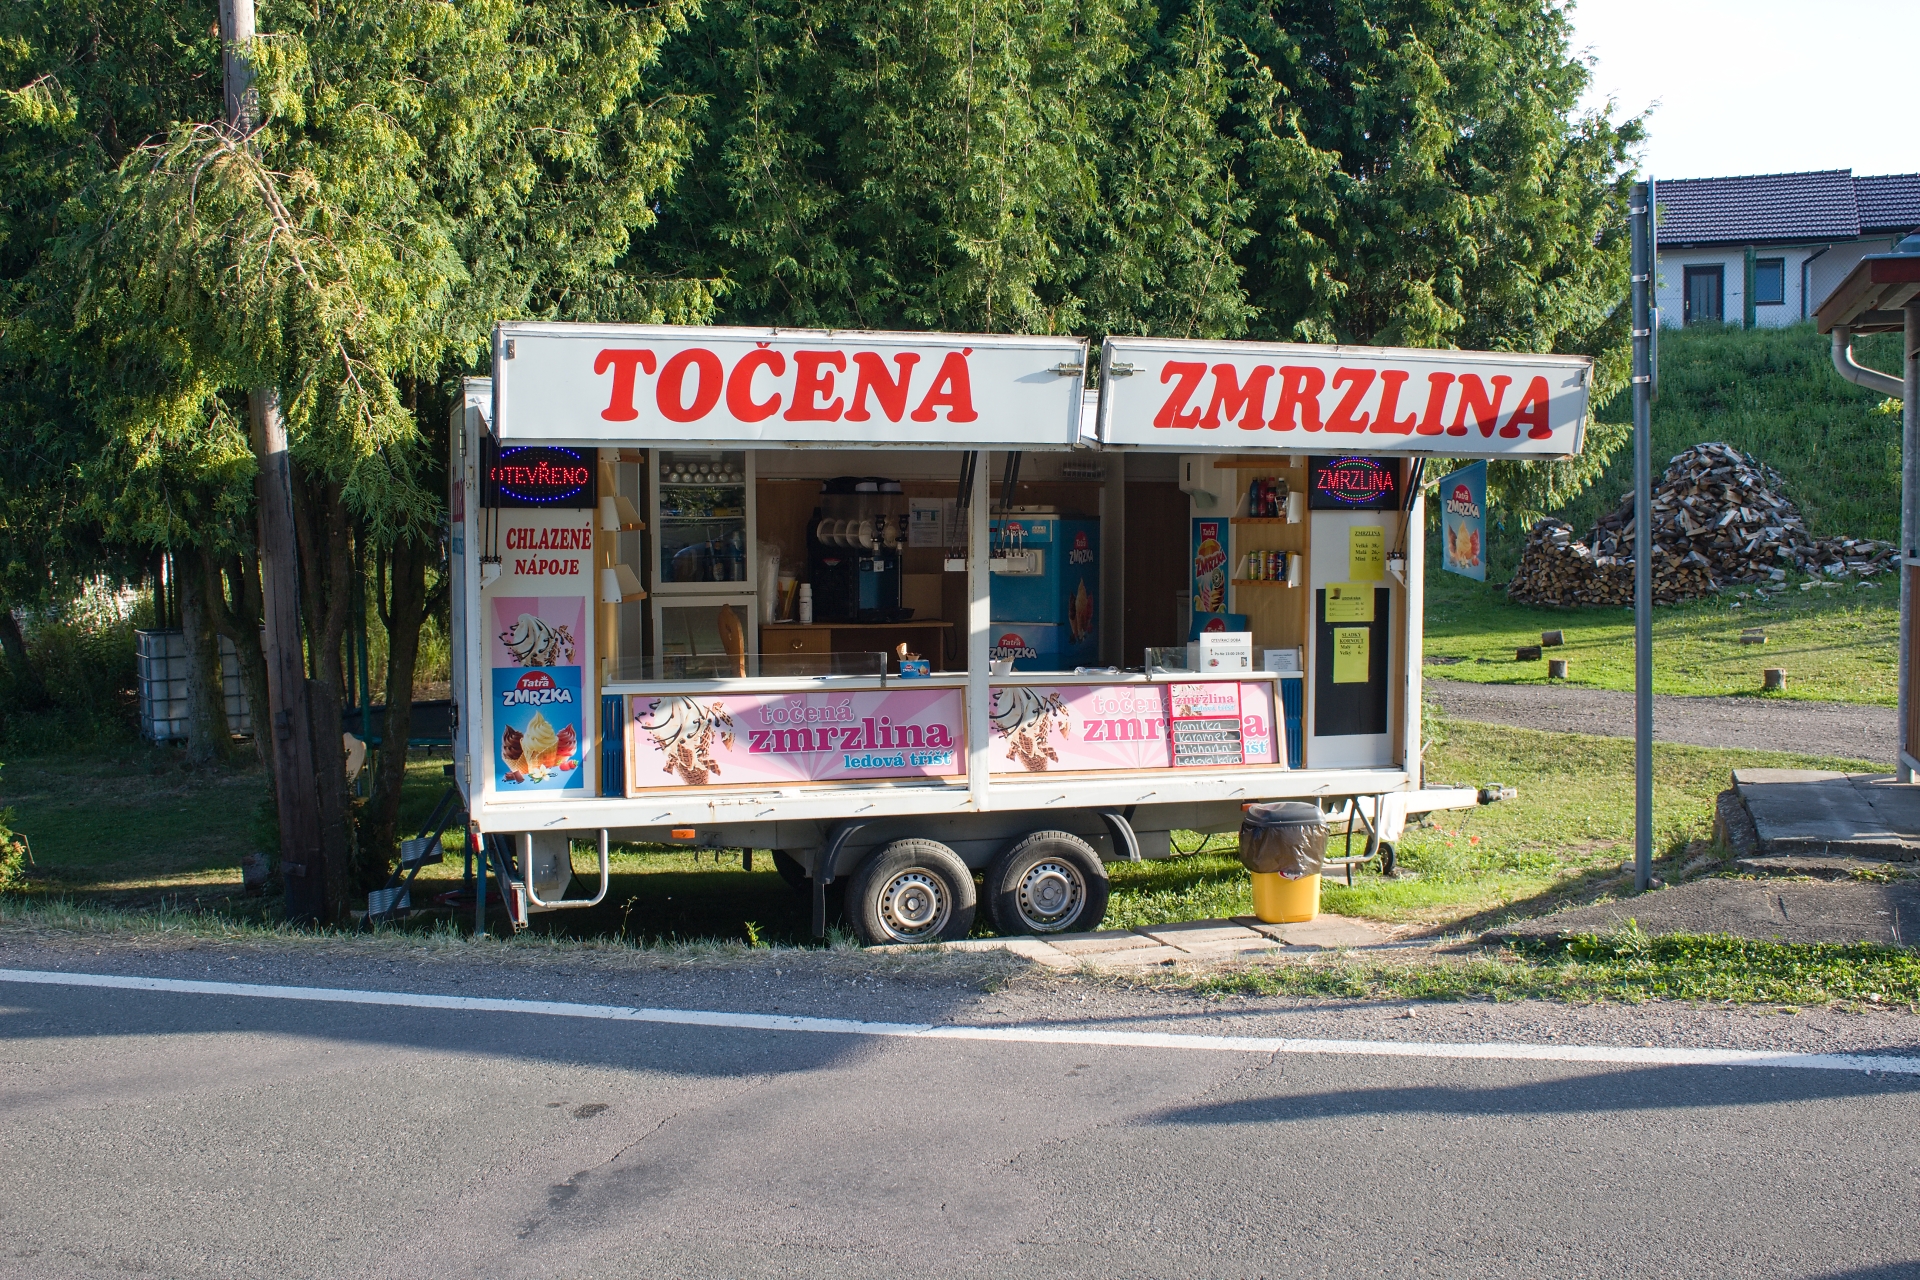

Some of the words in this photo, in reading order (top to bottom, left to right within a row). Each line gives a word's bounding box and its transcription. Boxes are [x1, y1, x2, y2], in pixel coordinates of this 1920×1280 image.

[593, 341, 979, 423] TOČENÁ
[1153, 360, 1553, 440] ZMRZLINA
[490, 461, 588, 485] OTEVŘENO
[1455, 490, 1469, 500] Tatra
[1447, 500, 1480, 519] ZMRZKA
[505, 521, 592, 550] CHLAZENÉ
[514, 553, 580, 575] NÁPOJE
[1069, 549, 1094, 565] ZMRZKA
[522, 679, 549, 687] Tatra
[503, 688, 573, 706] ZMRZKA
[1175, 694, 1235, 705] zmrzlina
[758, 698, 854, 725] točená
[748, 715, 953, 754] zmrzlina
[1175, 720, 1221, 731] Vanilka
[1179, 731, 1228, 742] Karamel
[844, 751, 905, 769] ledová
[909, 749, 953, 766] tříšť
